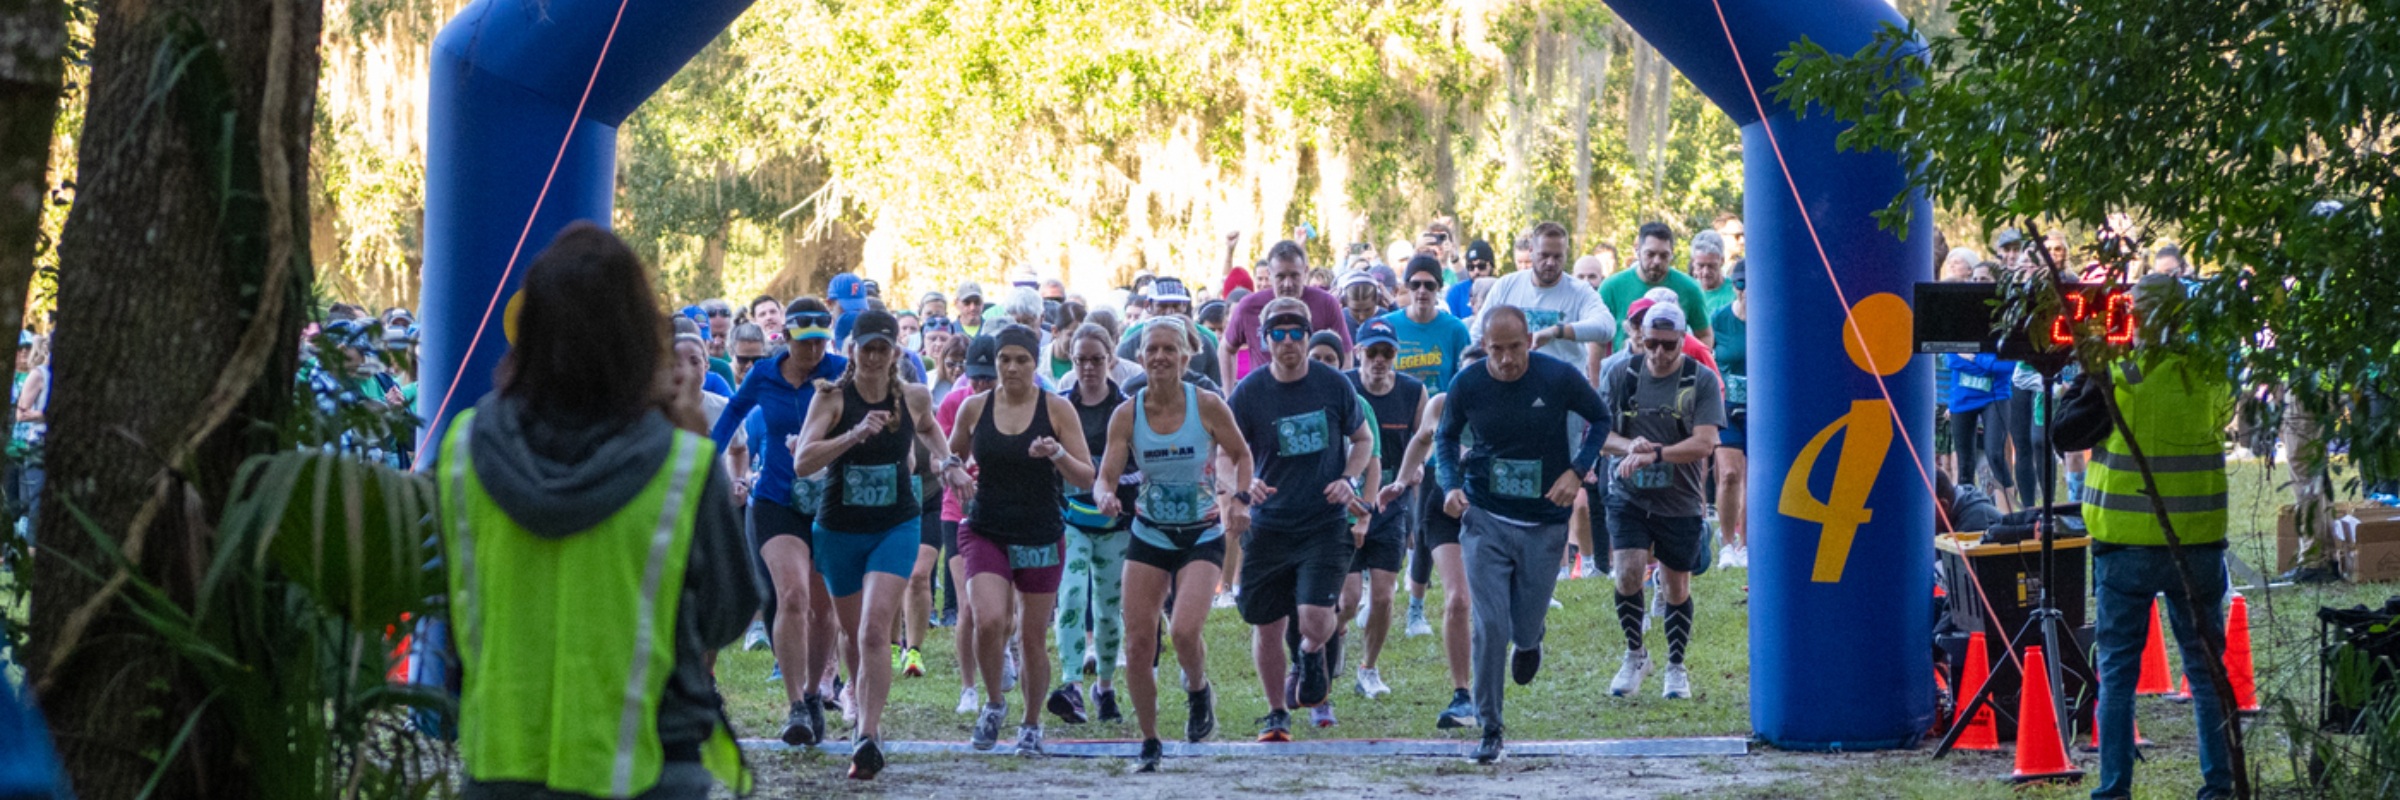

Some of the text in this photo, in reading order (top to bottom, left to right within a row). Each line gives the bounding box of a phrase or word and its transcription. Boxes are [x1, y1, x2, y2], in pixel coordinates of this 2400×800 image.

[1394, 352, 1442, 370] LEGENDS
[1287, 432, 1323, 454] 335
[1636, 470, 1666, 488] 173
[852, 486, 889, 505] 207
[1153, 501, 1189, 520] 332
[1015, 547, 1050, 568] 307
